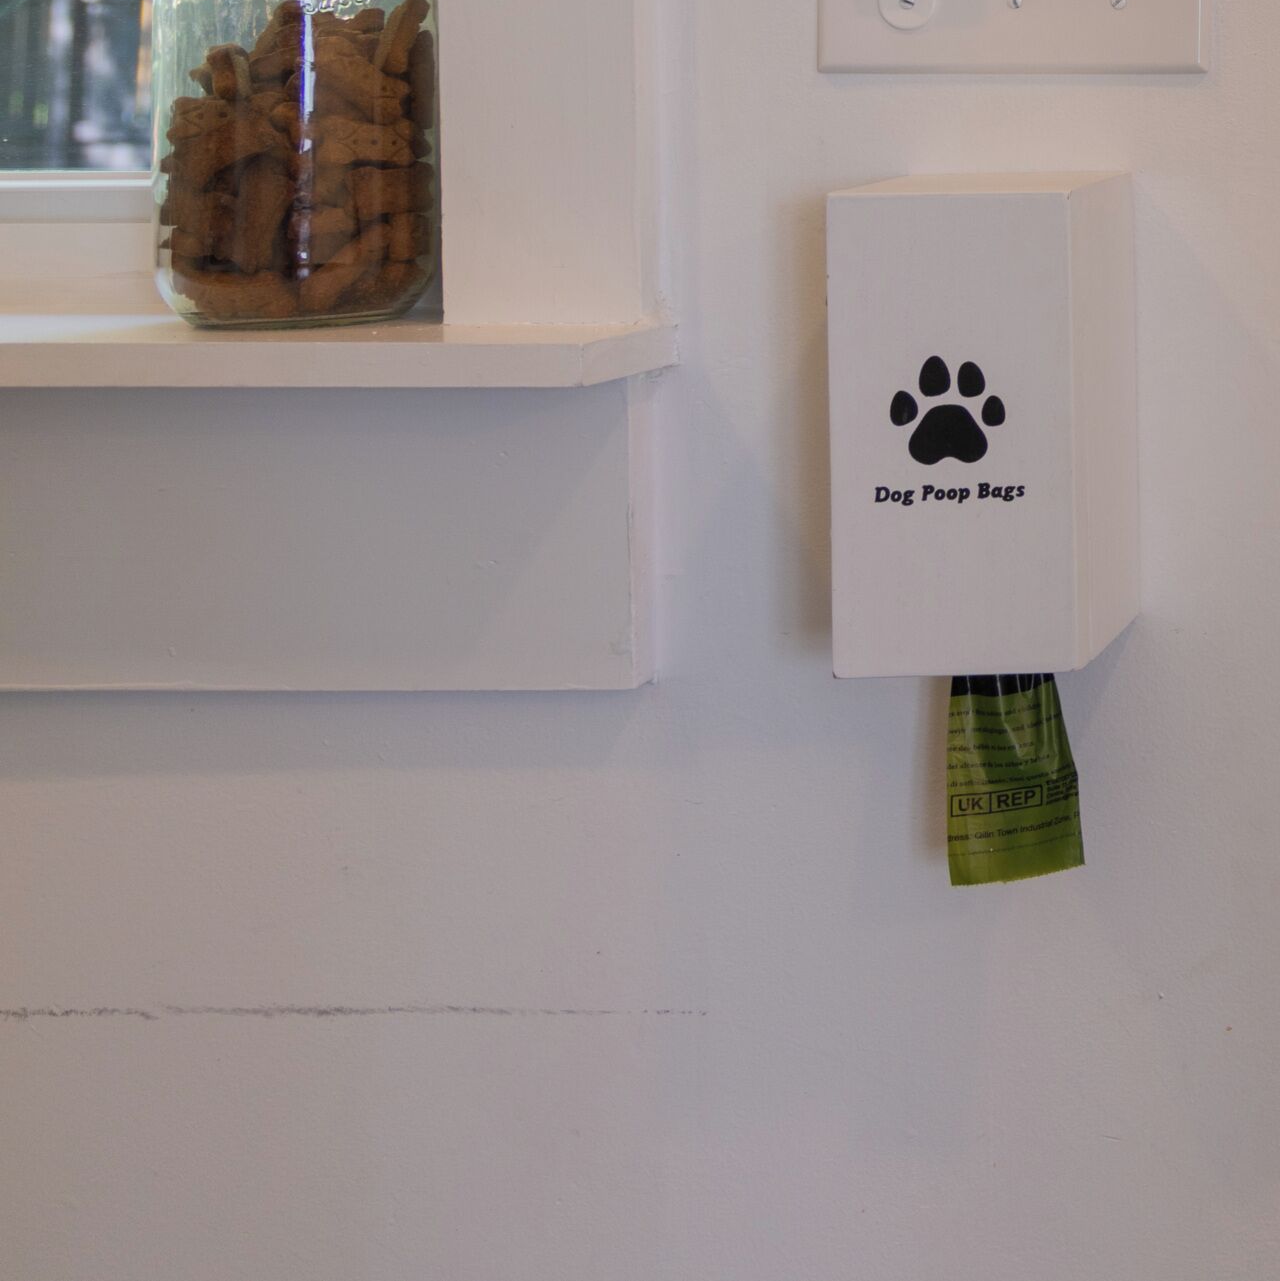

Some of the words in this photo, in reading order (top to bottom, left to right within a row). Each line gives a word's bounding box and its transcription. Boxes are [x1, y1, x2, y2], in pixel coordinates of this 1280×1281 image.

[874, 486, 915, 506] Dog
[921, 484, 971, 504] Poop
[977, 482, 1025, 502] Bags
[958, 797, 984, 812] UK
[996, 789, 1036, 809] REP
[998, 826, 1019, 837] Town
